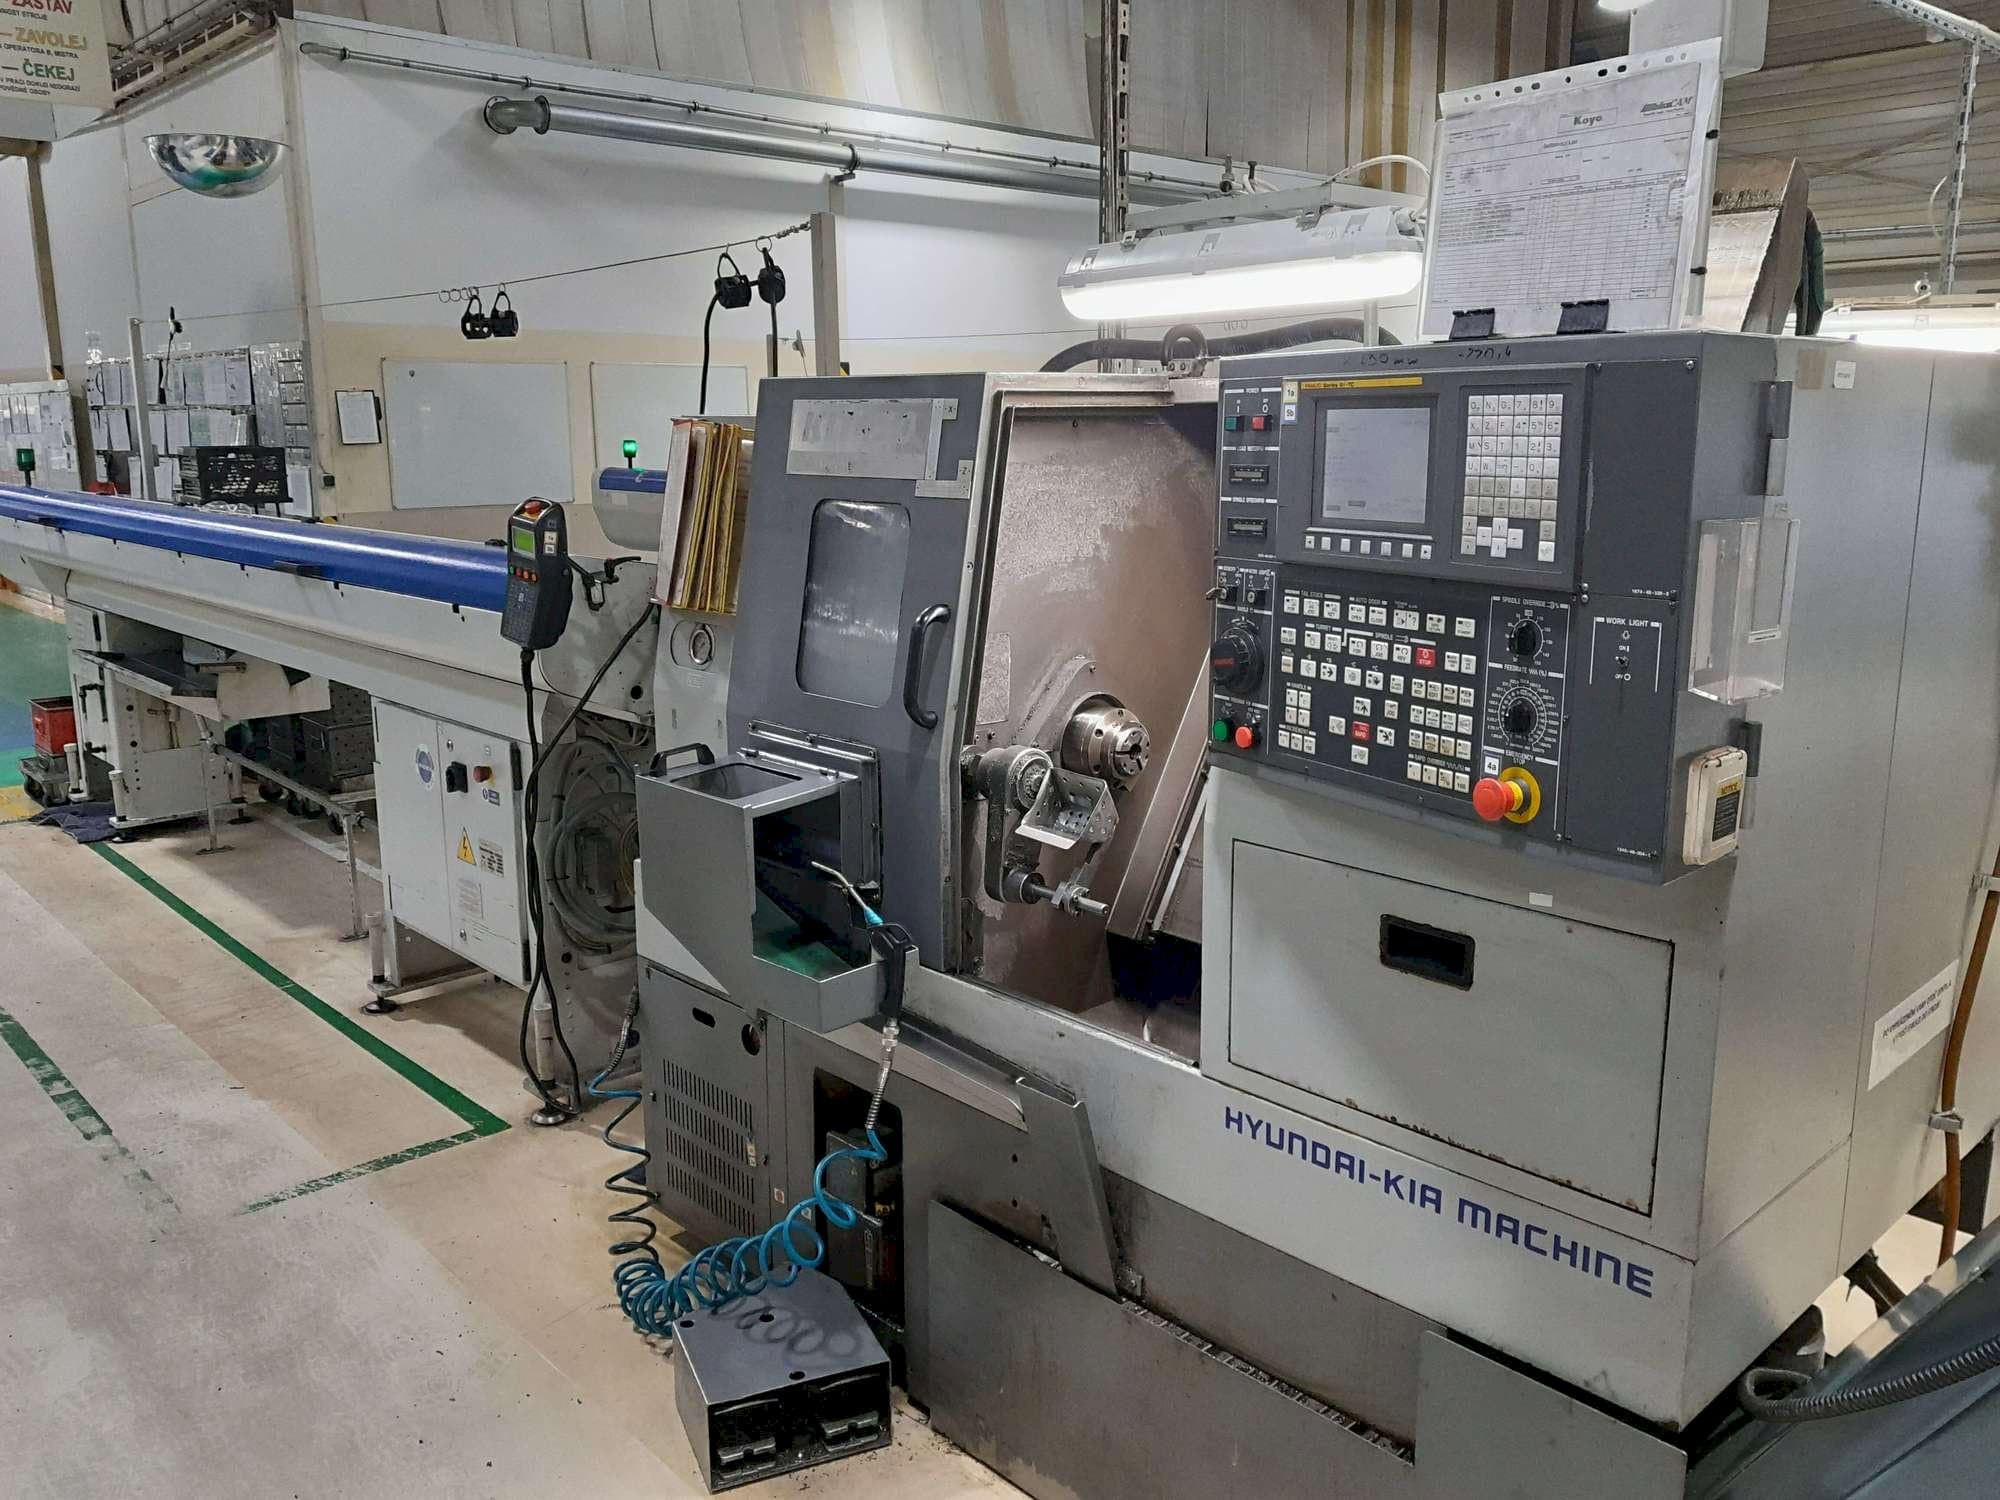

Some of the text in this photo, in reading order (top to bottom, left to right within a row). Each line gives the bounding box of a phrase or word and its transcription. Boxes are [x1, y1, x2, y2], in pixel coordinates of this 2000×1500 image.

[15, 26, 88, 50] ZAVOLEJ
[23, 58, 75, 81] ČEKEJ
[1573, 114, 1603, 126] Koyo
[1606, 617, 1648, 628] WORK LIGHT
[1505, 749, 1534, 761] EMERGENCY
[1487, 762, 1497, 770] 4a
[1225, 1106, 1655, 1298] HYUNDAI-KIA MACHINE
